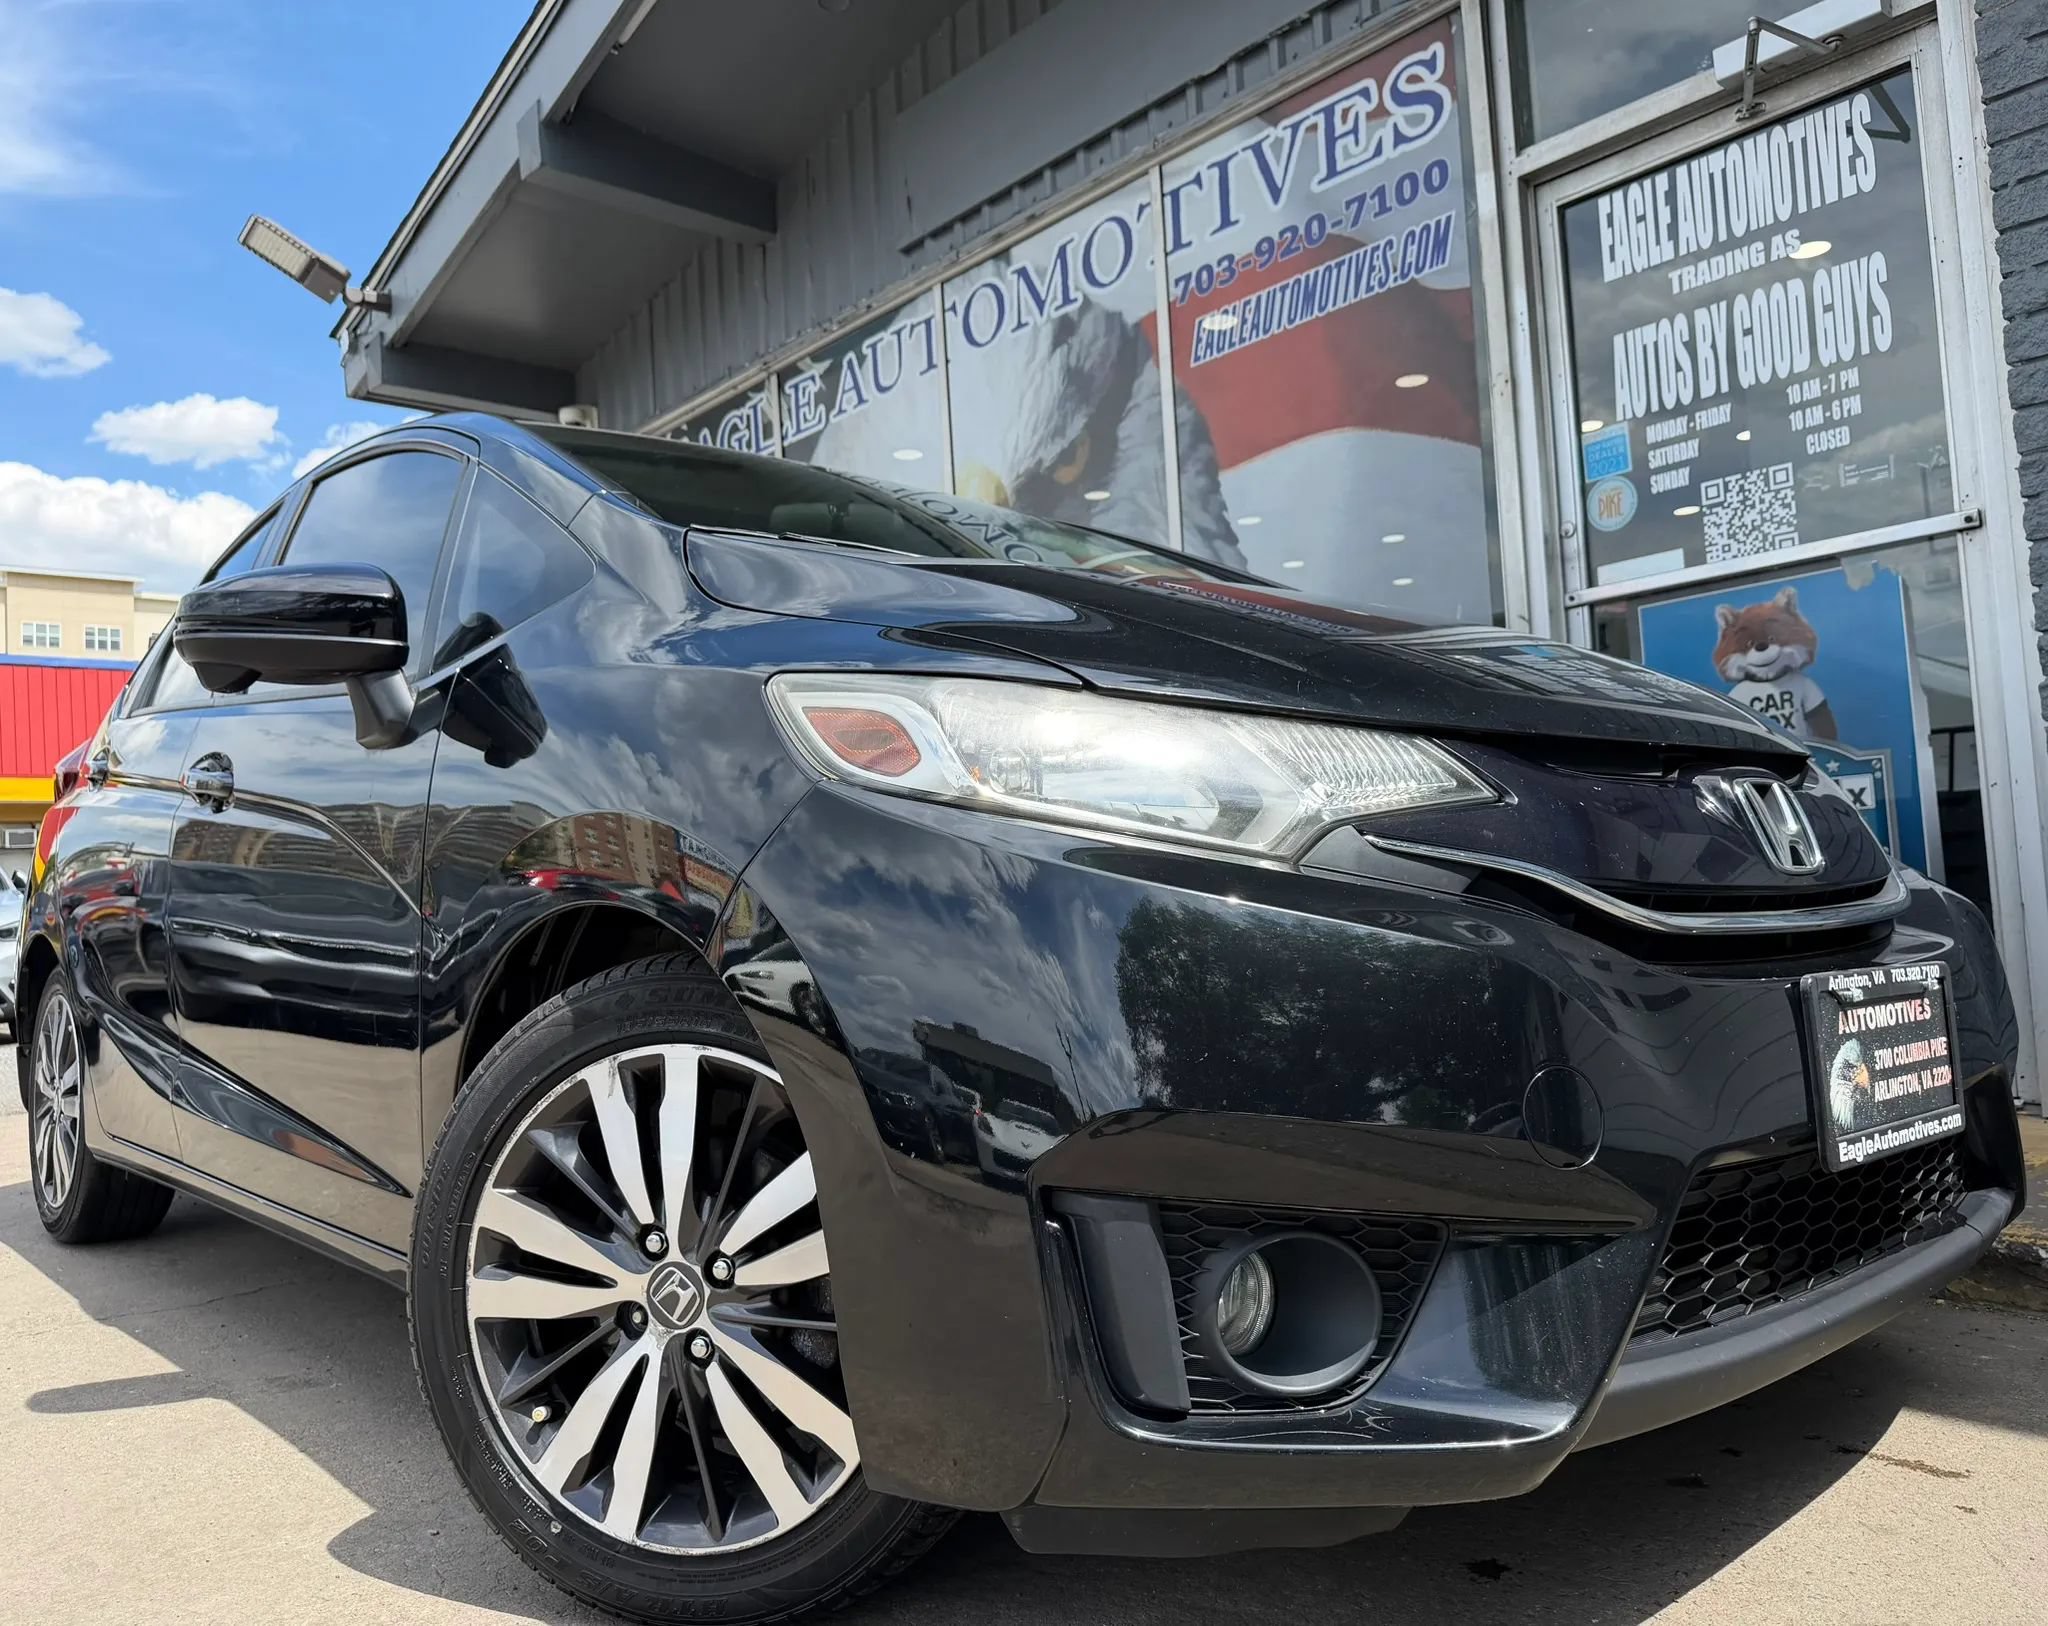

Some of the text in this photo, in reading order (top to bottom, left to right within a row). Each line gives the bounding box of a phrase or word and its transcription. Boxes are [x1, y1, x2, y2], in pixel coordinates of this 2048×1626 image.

[1598, 93, 1878, 283] EAGLE AUTOMOTIVES
[832, 42, 1452, 424] AUTOMOTIVES
[1174, 158, 1450, 306] 703-920-7100
[1668, 228, 1801, 294] TRADING AS
[1191, 211, 1455, 366] EAGLEAUTOMOTIVES.COM
[1613, 251, 1893, 421] AUTOS BY GOOD GUYS
[1840, 366, 1860, 391] PM
[1646, 415, 1688, 445] MONDAY
[1695, 402, 1731, 431] FRIDAY
[1842, 394, 1862, 418] PM
[1647, 438, 1701, 470] SATURDAY
[1806, 425, 1851, 455] CLOSED
[1590, 456, 1626, 477] 2021
[1649, 466, 1691, 495] SUNDAY
[1749, 690, 1795, 713] CAR
[1828, 973, 1872, 991] Arlington,
[1872, 970, 1886, 985] VA
[1839, 998, 1931, 1034] AUTOMOTIVES
[1929, 1037, 1948, 1057] PIKE
[1874, 1070, 1921, 1102] ARLINGTON,
[1921, 1067, 1933, 1090] VA
[1838, 1113, 1962, 1162] EagleAutomotives.com
